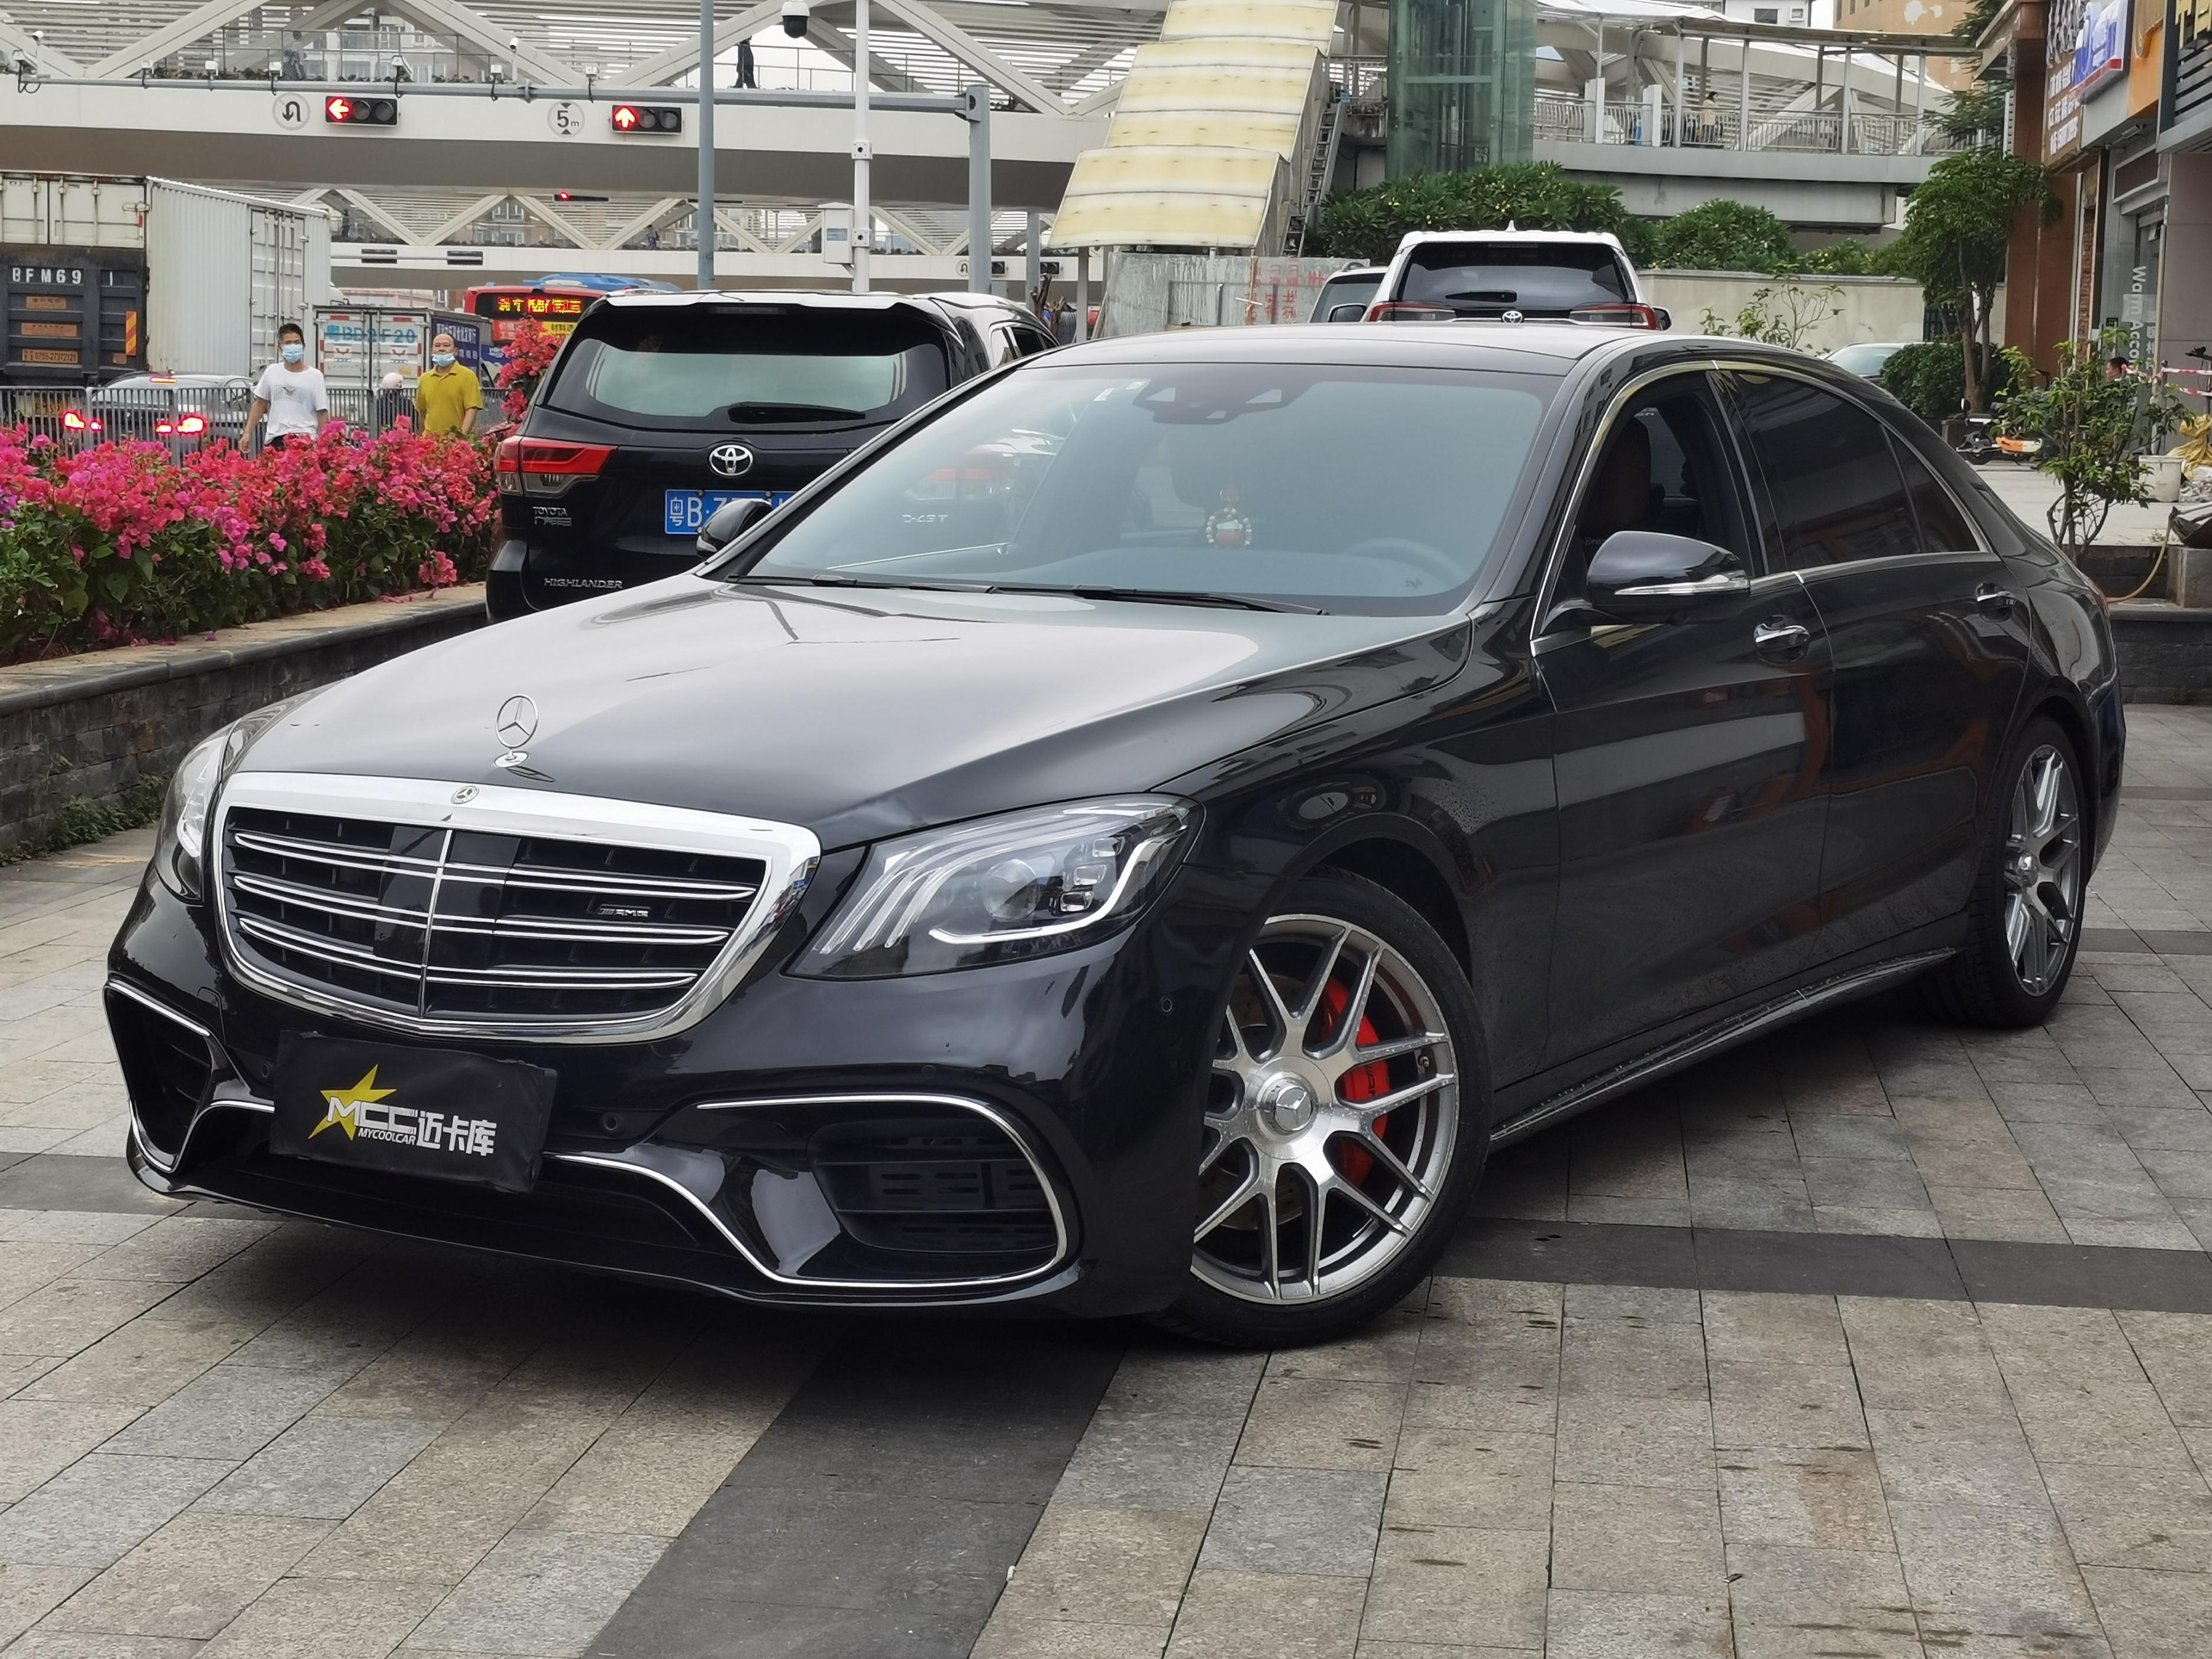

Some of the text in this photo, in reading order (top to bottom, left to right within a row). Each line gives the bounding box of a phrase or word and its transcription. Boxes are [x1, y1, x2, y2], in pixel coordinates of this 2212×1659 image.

[557, 110, 579, 128] 5m
[532, 506, 568, 517] TOYOTA
[544, 578, 623, 589] HIGHLANDER
[357, 1127, 416, 1145] MYCOOLCAR
[416, 1110, 497, 1156] 迈卡库
